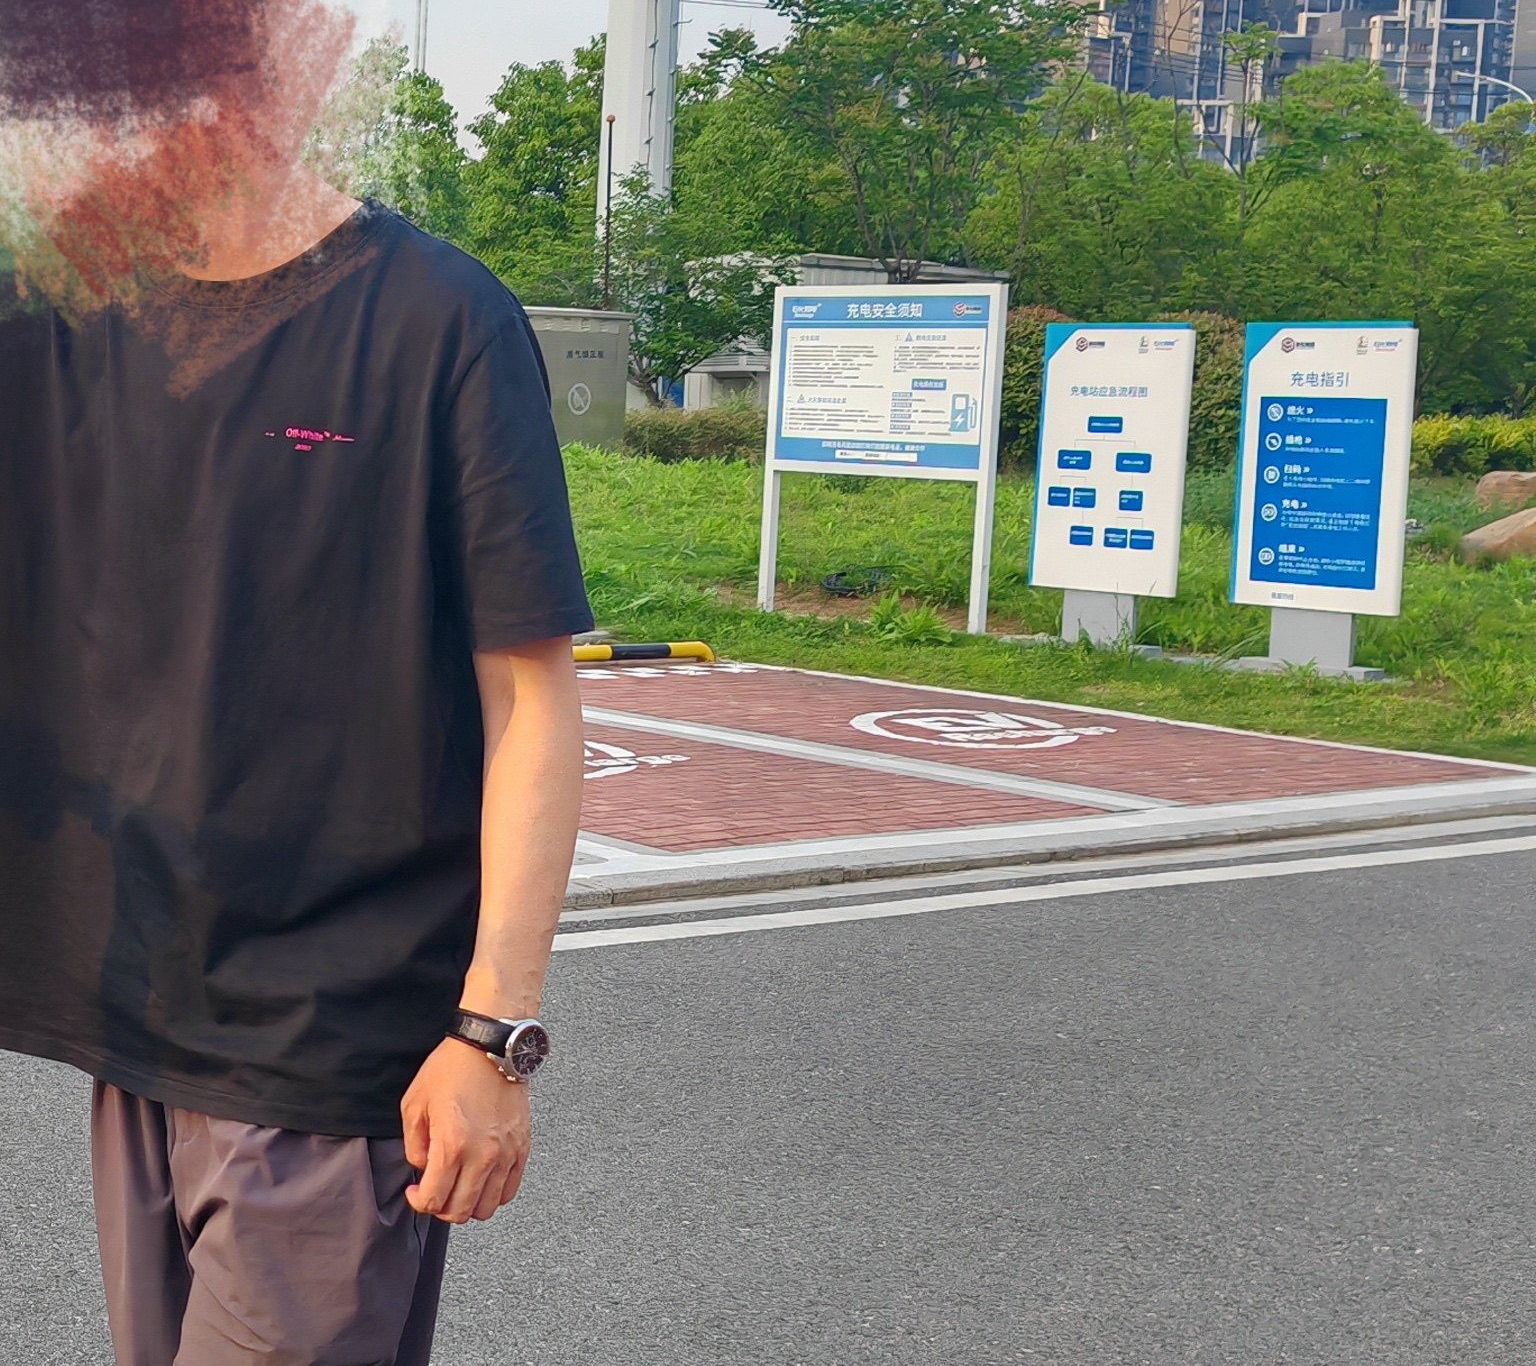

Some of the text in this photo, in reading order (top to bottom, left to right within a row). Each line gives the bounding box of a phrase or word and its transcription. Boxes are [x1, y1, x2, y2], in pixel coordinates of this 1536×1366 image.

[846, 303, 924, 319] 充电安全须知
[1290, 371, 1350, 388] 充电指引
